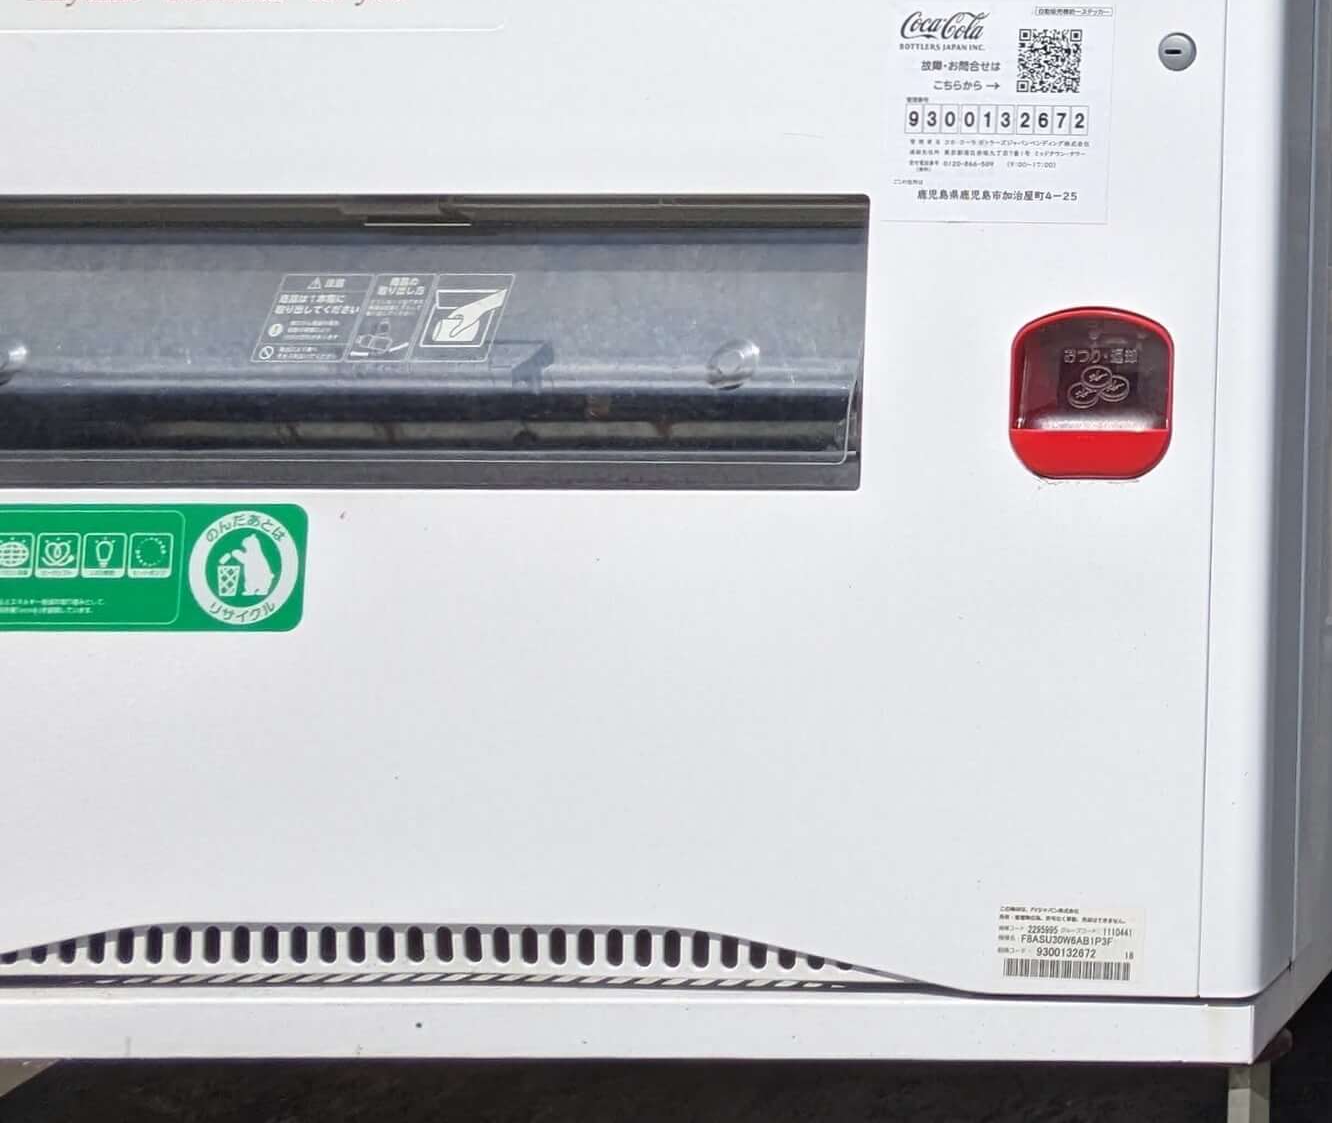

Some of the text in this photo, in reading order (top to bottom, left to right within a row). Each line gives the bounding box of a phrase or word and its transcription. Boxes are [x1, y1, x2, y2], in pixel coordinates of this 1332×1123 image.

[899, 43, 941, 52] BOTTLERS
[942, 44, 968, 52] JAPAN
[933, 80, 983, 91] こちらから
[206, 514, 286, 543] のんだあとは
[208, 600, 277, 624] リサイクル
